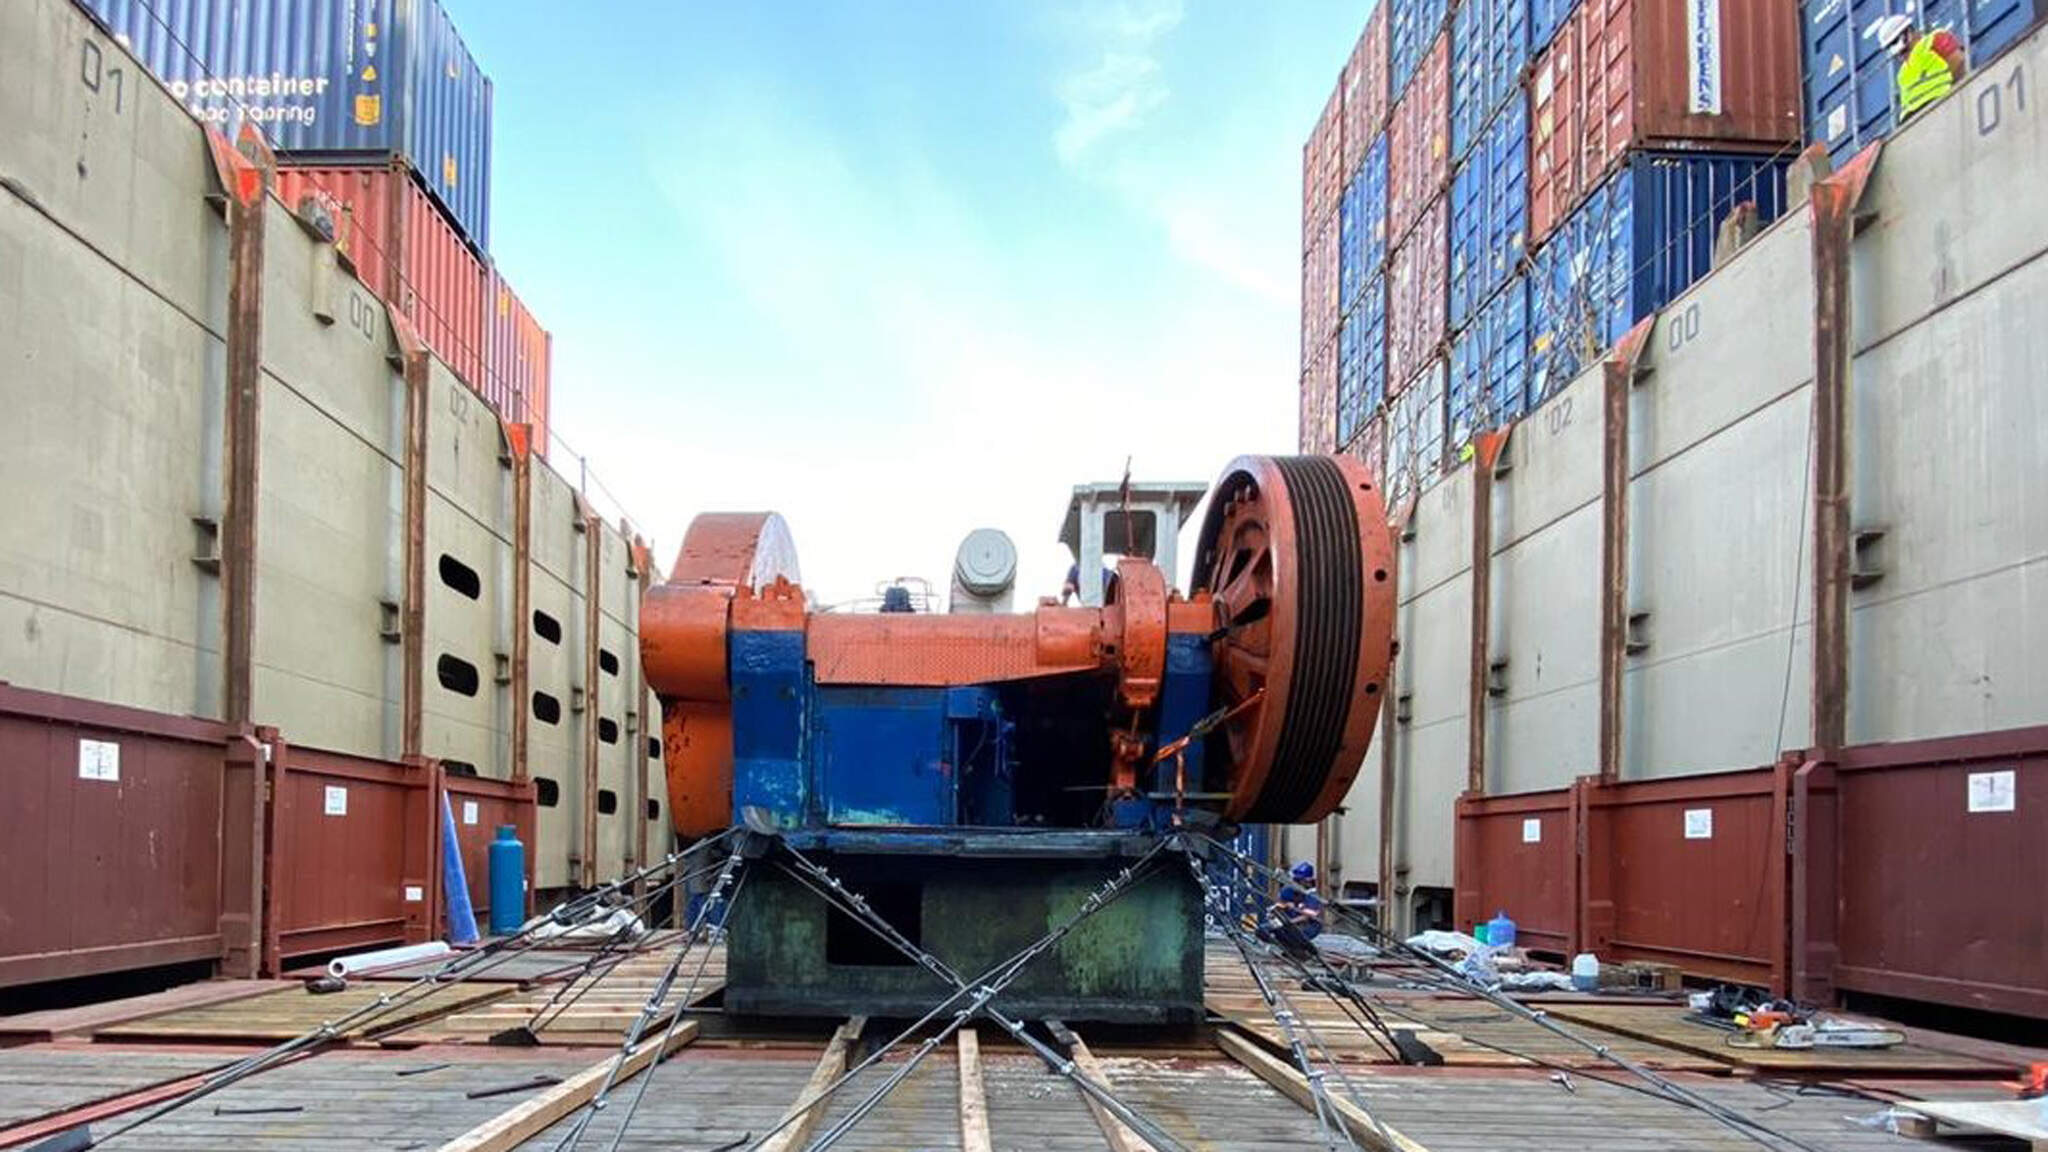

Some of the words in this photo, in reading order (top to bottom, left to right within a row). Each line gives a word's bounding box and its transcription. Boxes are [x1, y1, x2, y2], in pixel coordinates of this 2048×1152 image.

[82, 38, 122, 114] 01
[195, 72, 328, 96] container
[1978, 65, 2025, 136] 01
[350, 290, 374, 340] 00
[1670, 303, 1699, 351] 00
[1551, 398, 1573, 435] 02
